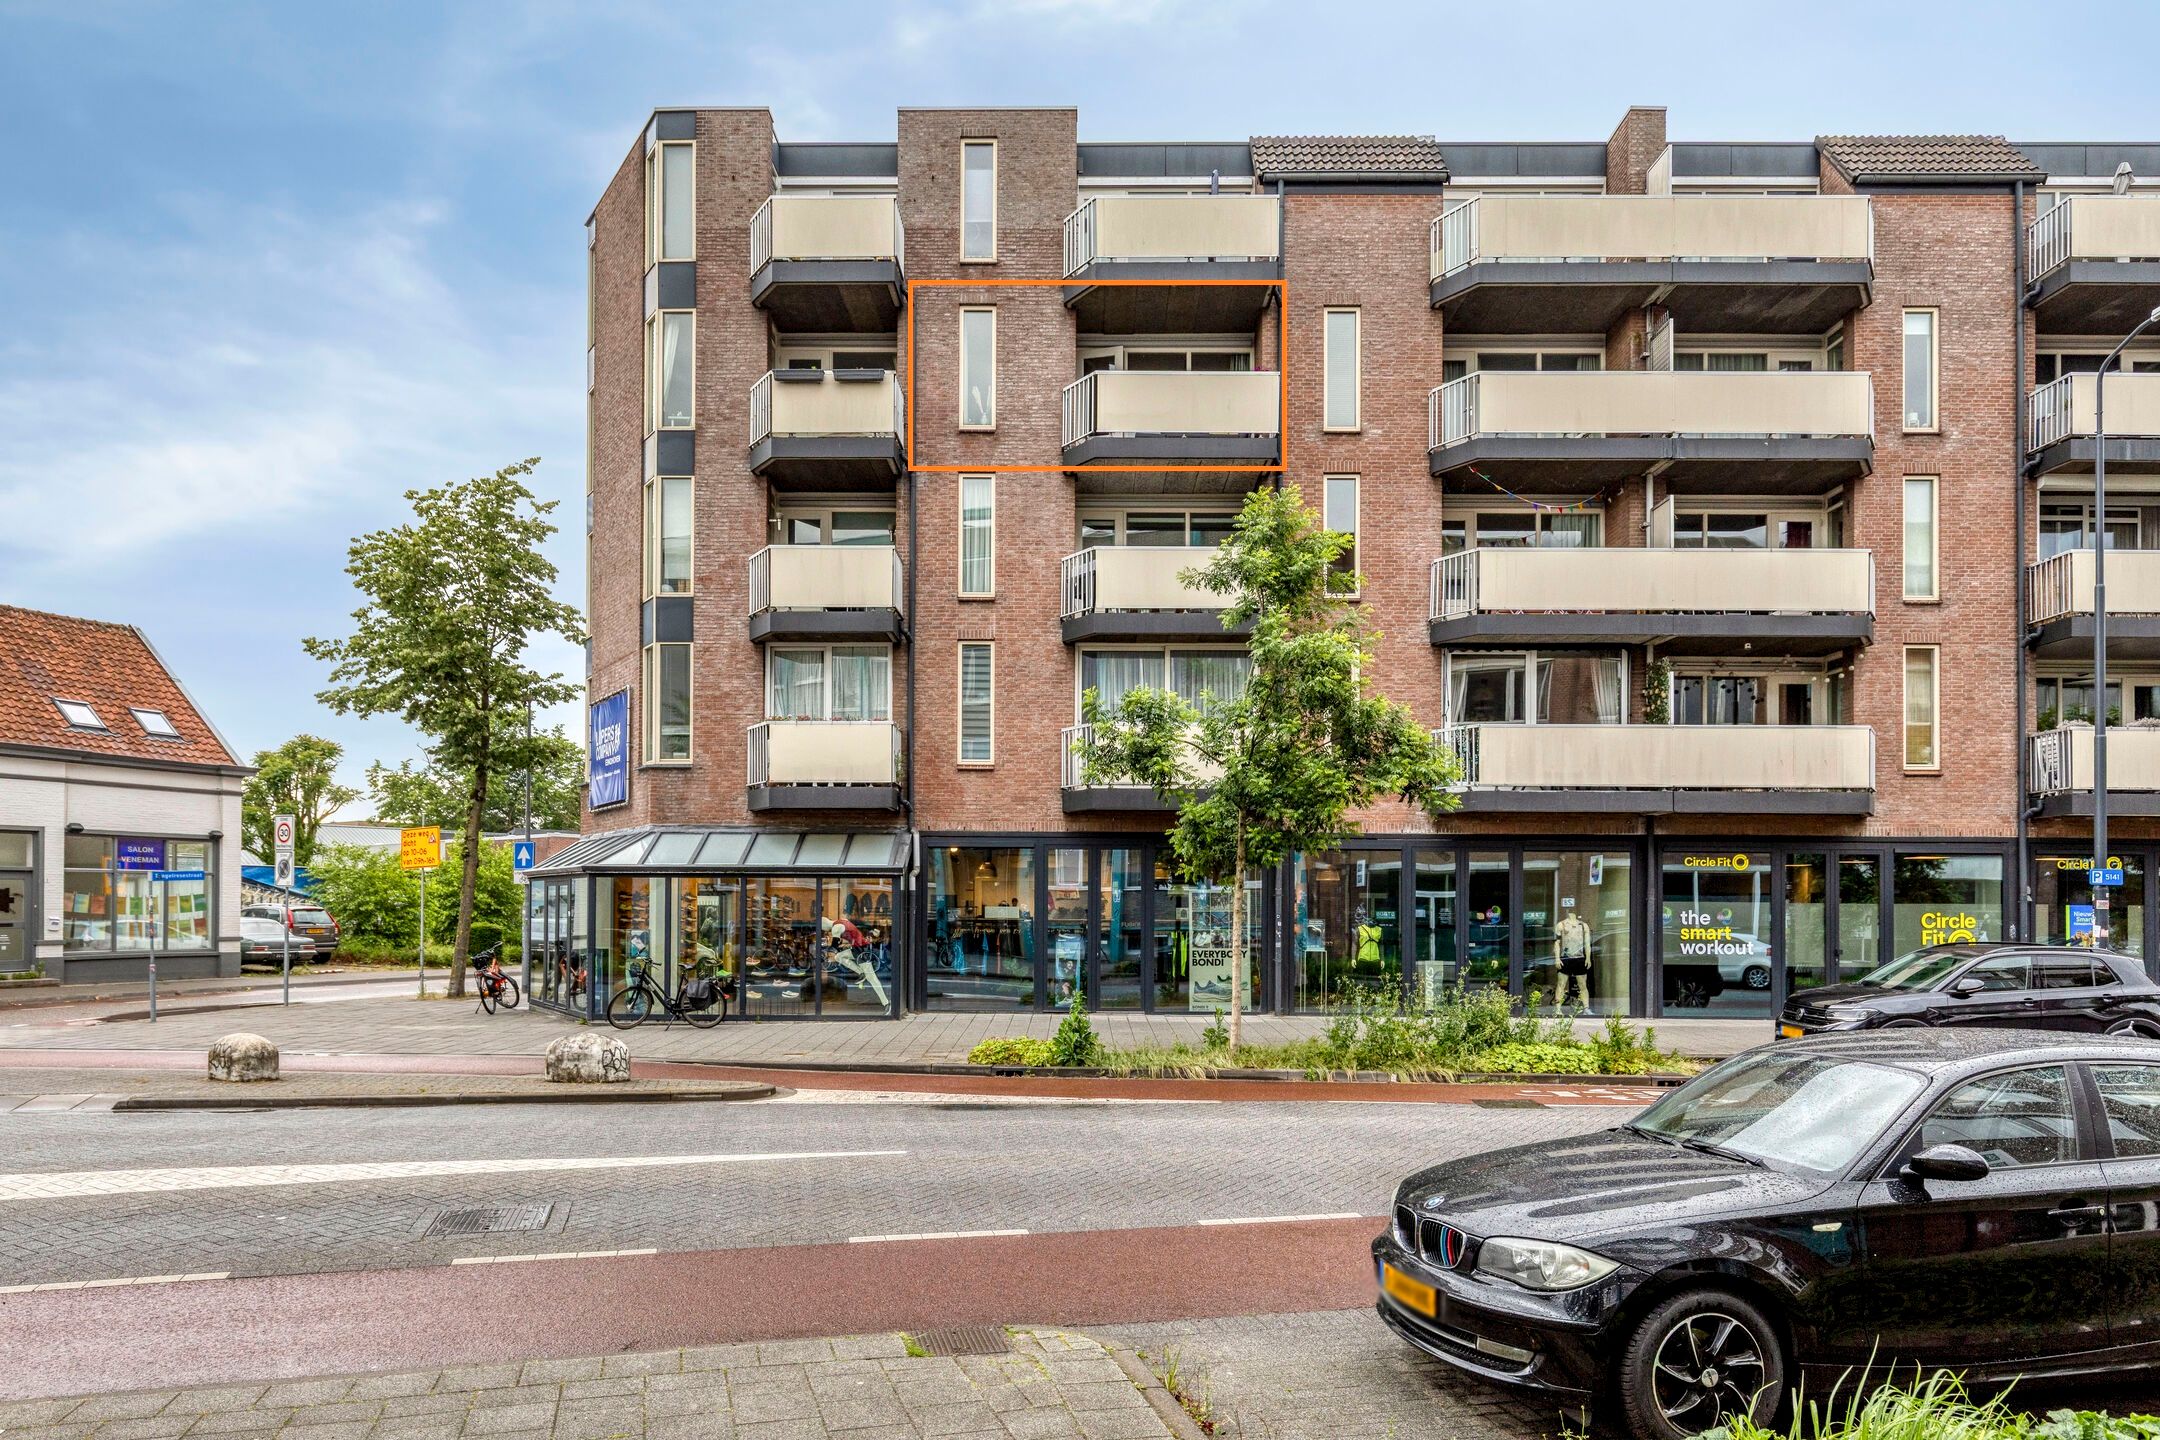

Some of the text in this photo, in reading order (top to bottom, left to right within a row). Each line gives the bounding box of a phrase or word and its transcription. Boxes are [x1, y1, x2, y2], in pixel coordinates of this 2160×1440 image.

[280, 828, 288, 837] 30
[402, 830, 429, 839] Deze weg
[411, 847, 427, 856] 10-06
[121, 856, 160, 864] VENEMAN
[1684, 857, 1732, 867] Circle Fit
[2057, 859, 2089, 870] Circle
[155, 872, 203, 880] Tngelresestraat
[1680, 909, 1711, 925] the
[1921, 912, 1977, 929] Circle
[1680, 926, 1732, 940] smart
[1922, 929, 1946, 945] Fit
[1680, 940, 1754, 955] workout
[1192, 950, 1248, 958] EVERYBOY
[1192, 958, 1224, 966] BONDI
